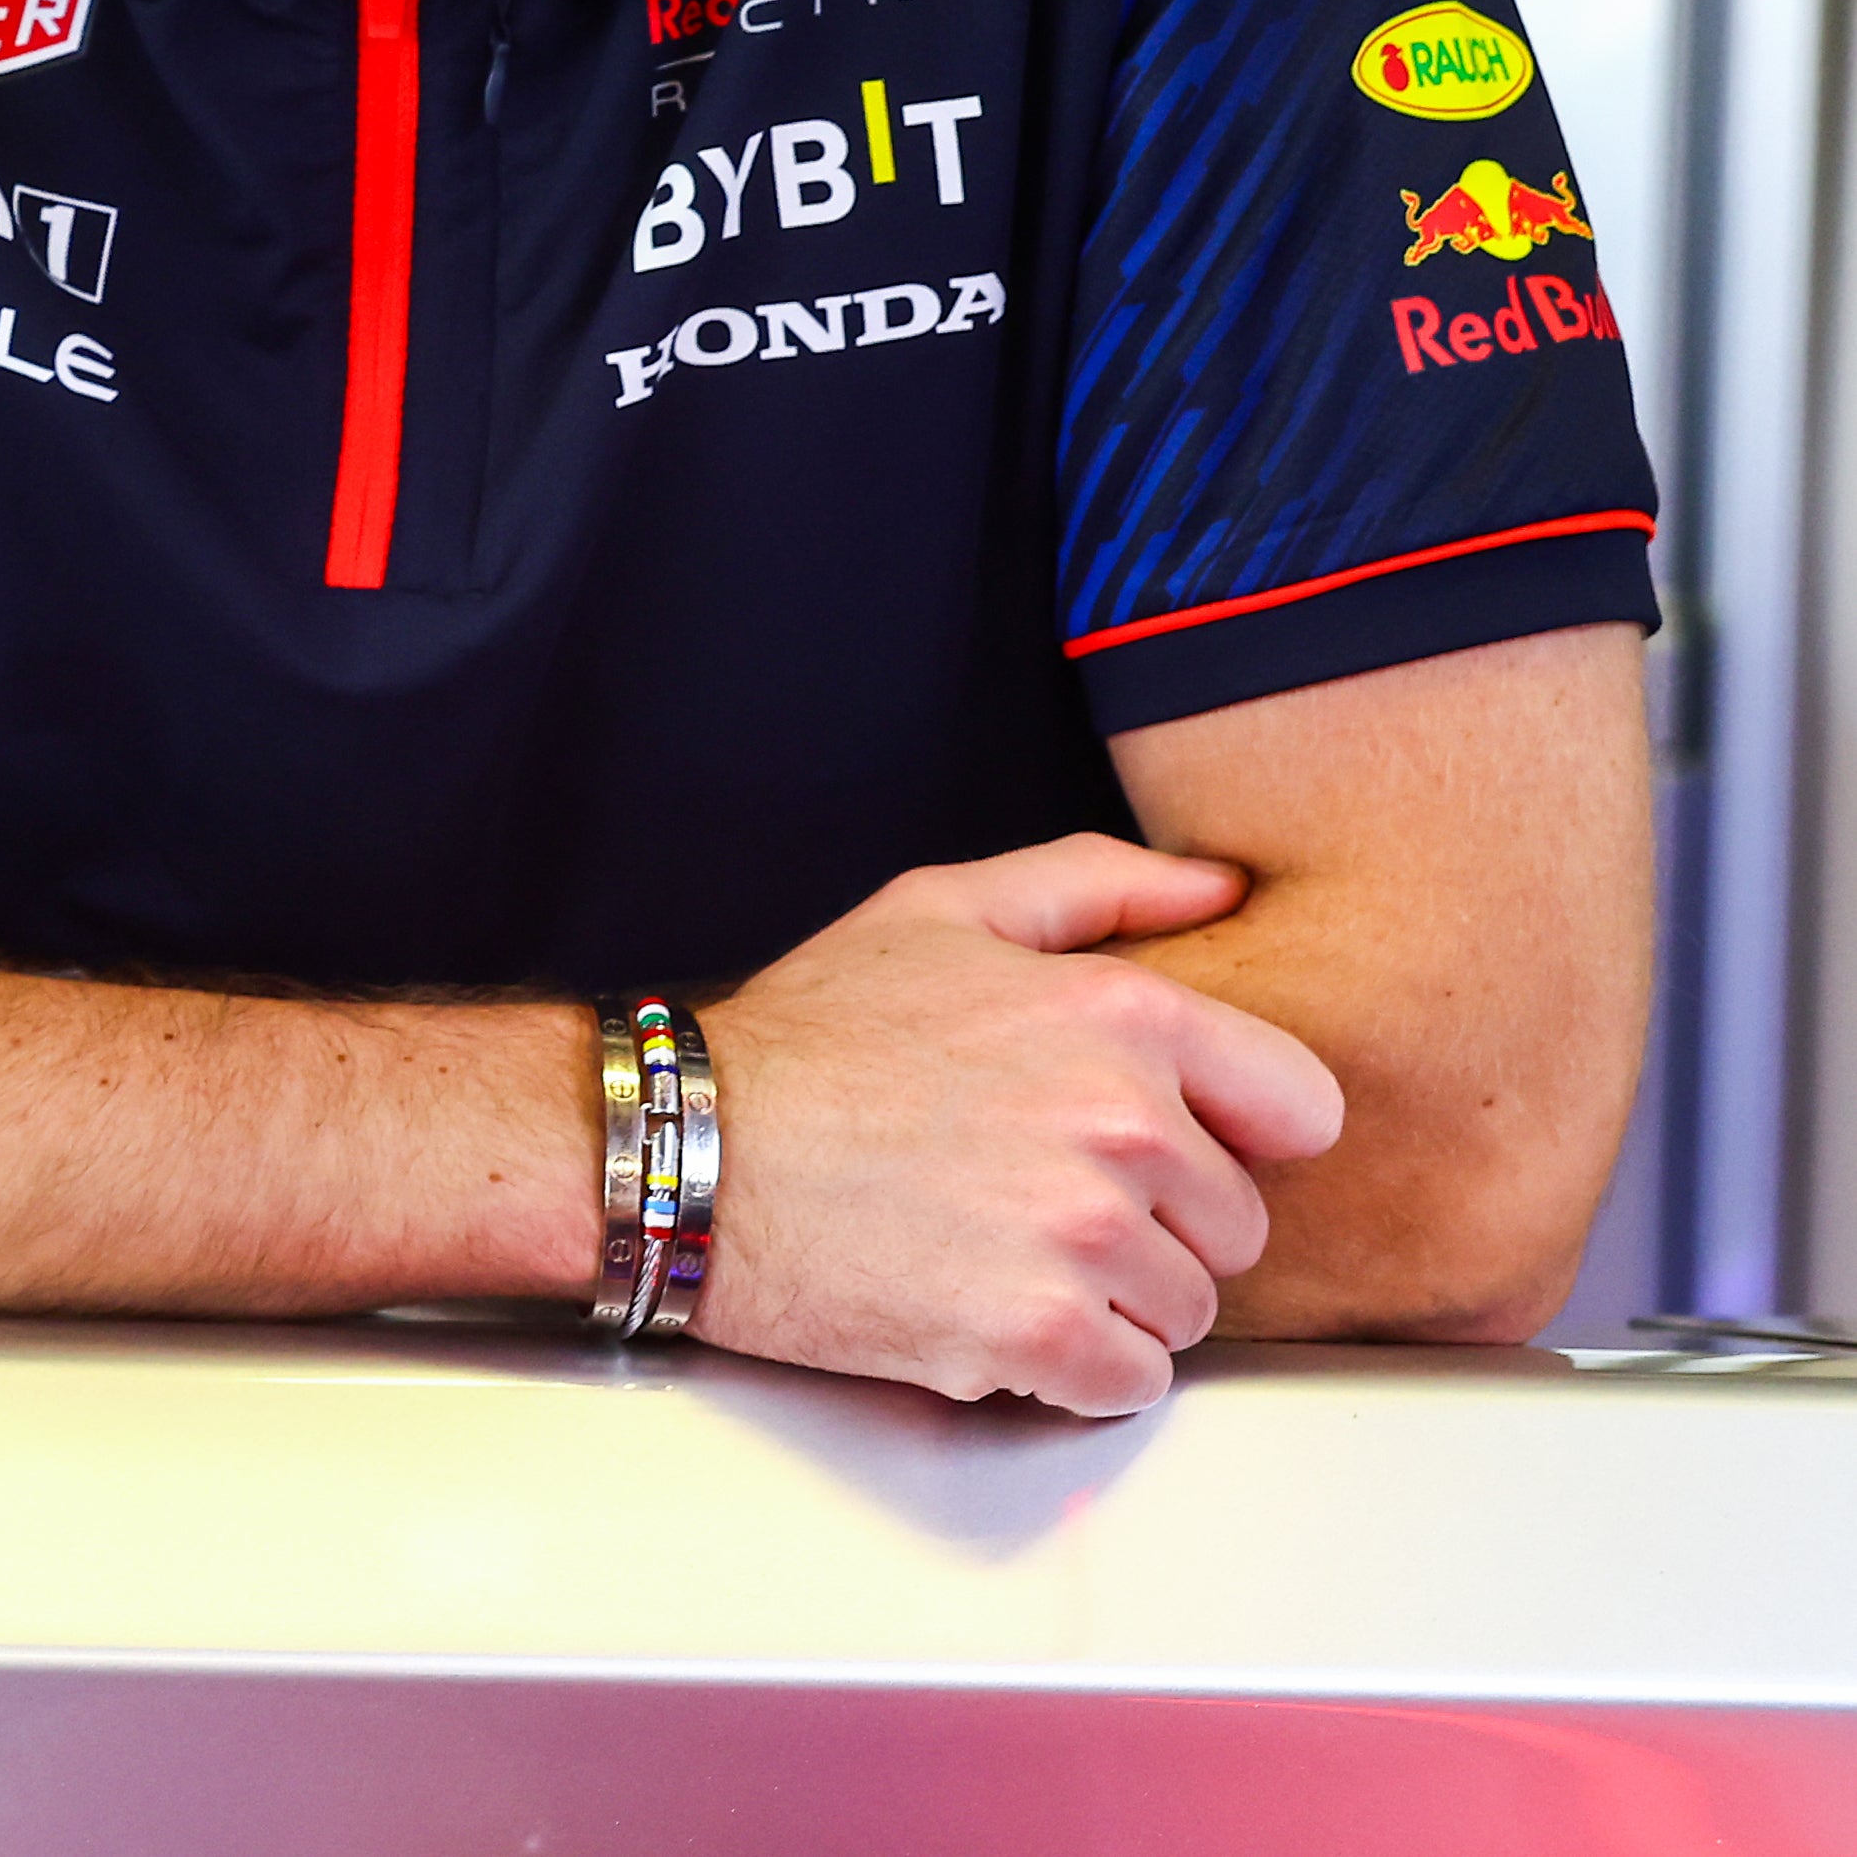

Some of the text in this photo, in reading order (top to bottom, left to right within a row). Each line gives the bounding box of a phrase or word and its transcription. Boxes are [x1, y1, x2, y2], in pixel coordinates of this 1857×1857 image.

[1411, 35, 1511, 89] RAUCH
[632, 78, 983, 274] BYBIT
[606, 271, 1007, 408] HONDA
